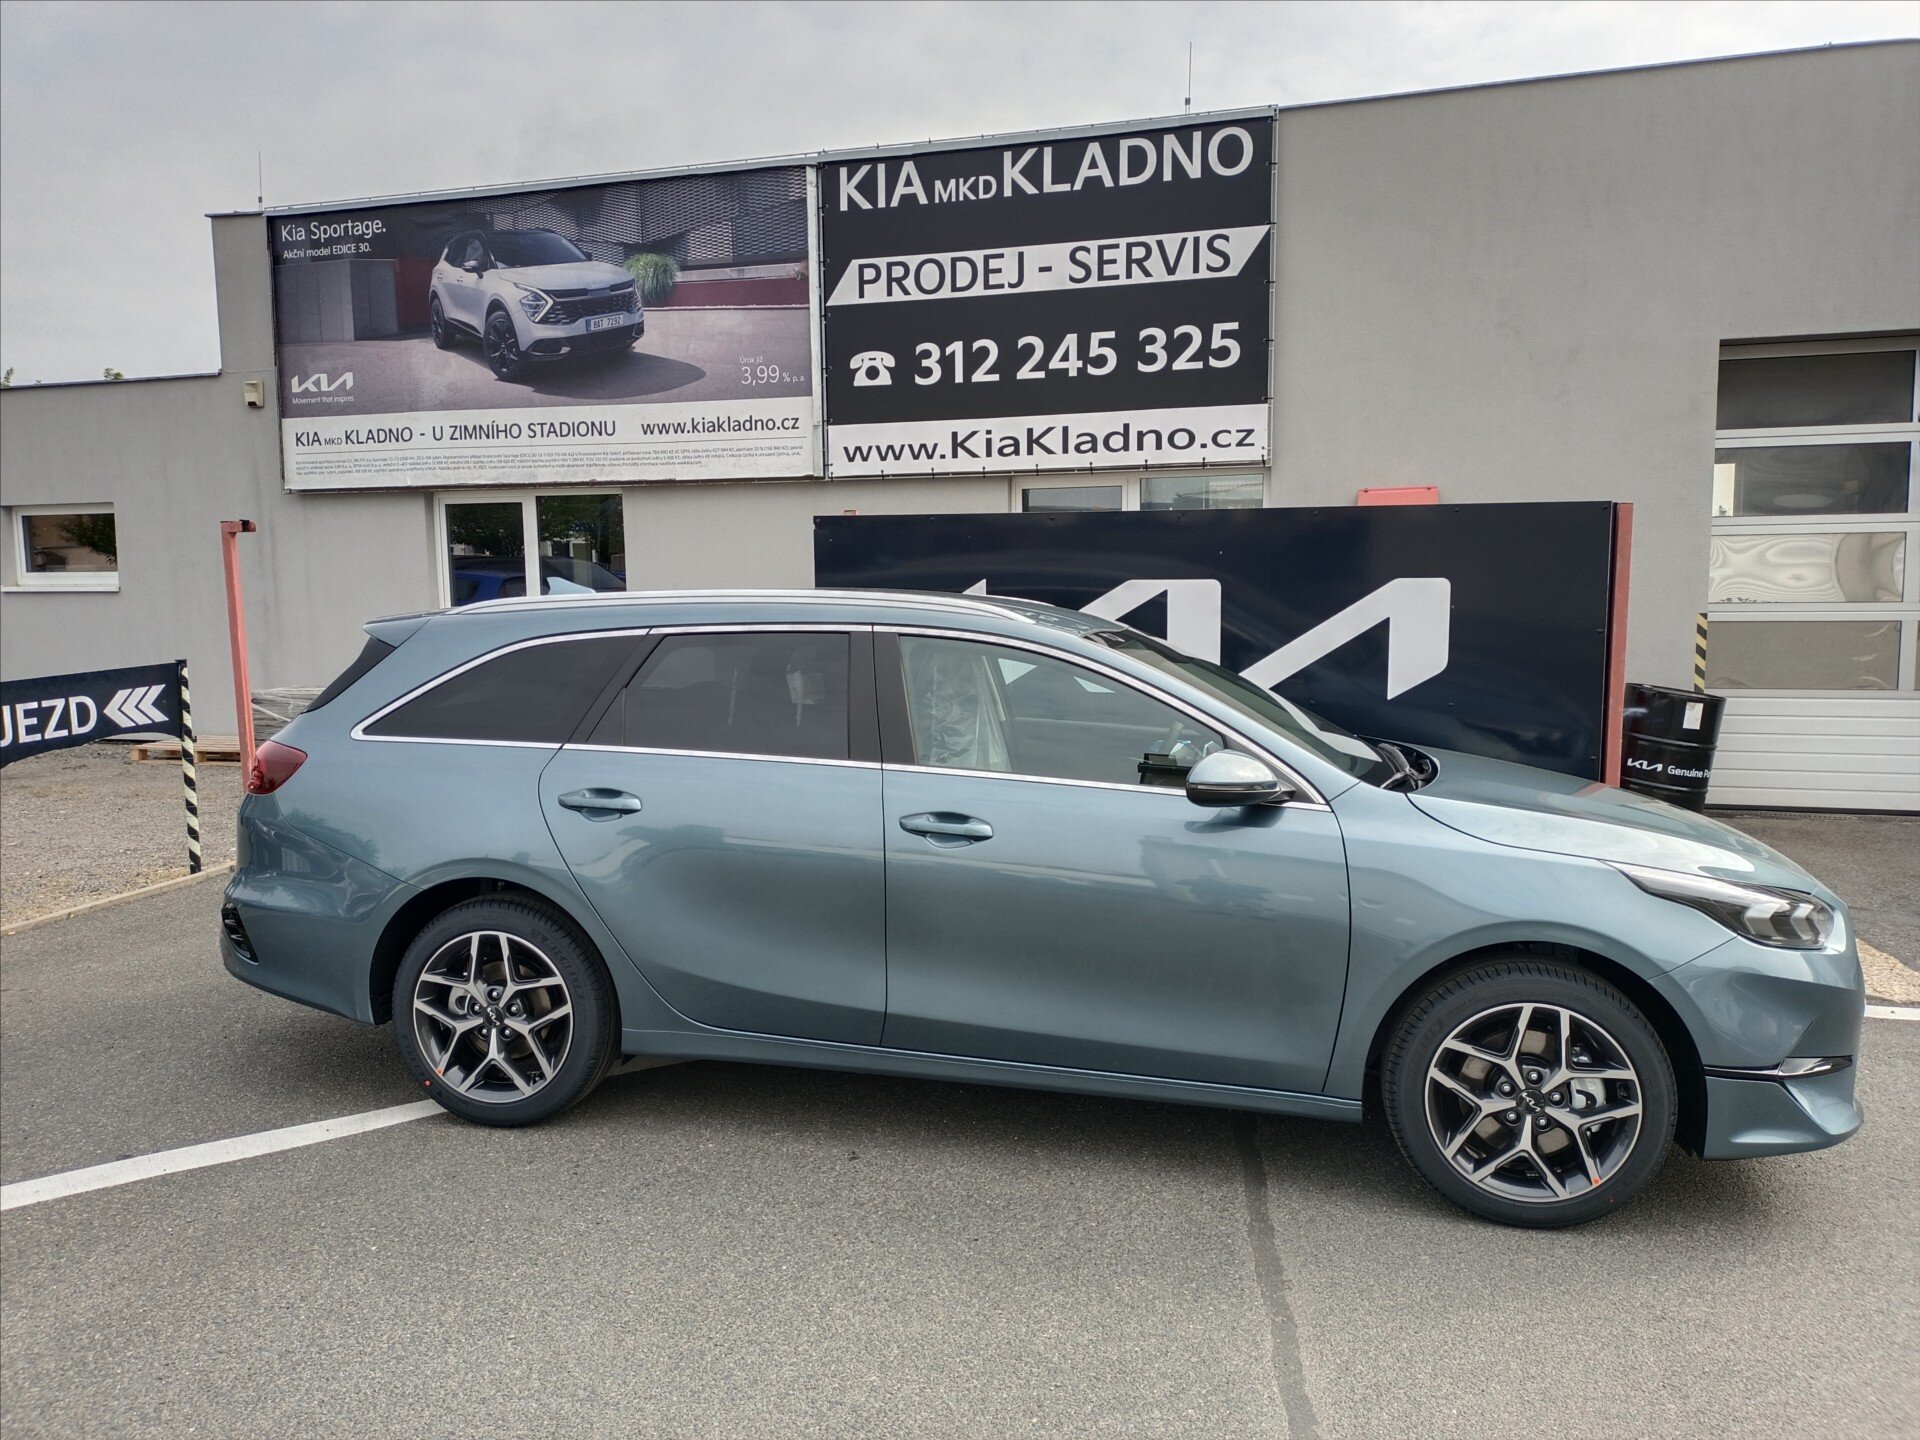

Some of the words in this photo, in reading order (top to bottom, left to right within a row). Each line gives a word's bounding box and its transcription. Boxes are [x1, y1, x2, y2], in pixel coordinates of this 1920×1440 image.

[839, 160, 929, 212] KIA
[934, 175, 998, 204] MKD
[1003, 126, 1254, 198] KLADNO
[281, 224, 306, 242] Kia
[310, 219, 386, 243] Sportage.
[283, 248, 305, 259] Akční
[306, 246, 331, 257] model
[332, 243, 357, 255] EDICE
[358, 242, 372, 253] 30.
[857, 251, 1025, 299] PRODEJ
[1068, 234, 1231, 284] SERVIS
[914, 339, 1000, 386] 312
[1017, 331, 1118, 380] 245
[1138, 322, 1241, 373] 325
[291, 371, 354, 393] KIA
[741, 364, 780, 386] 3,99
[782, 372, 791, 382] %
[292, 397, 321, 405] Movement
[321, 395, 333, 403] that
[295, 431, 322, 447] KIA
[324, 437, 343, 446] MKD
[344, 426, 413, 445] KLADNO
[432, 425, 444, 441] U
[449, 420, 522, 441] ZIMNÍHO
[527, 419, 616, 439] STADIONU
[641, 415, 800, 435] www.kiakladno.cz
[843, 422, 1255, 463] www.KiaKladno.cz
[1667, 765, 1703, 778] Genuine
